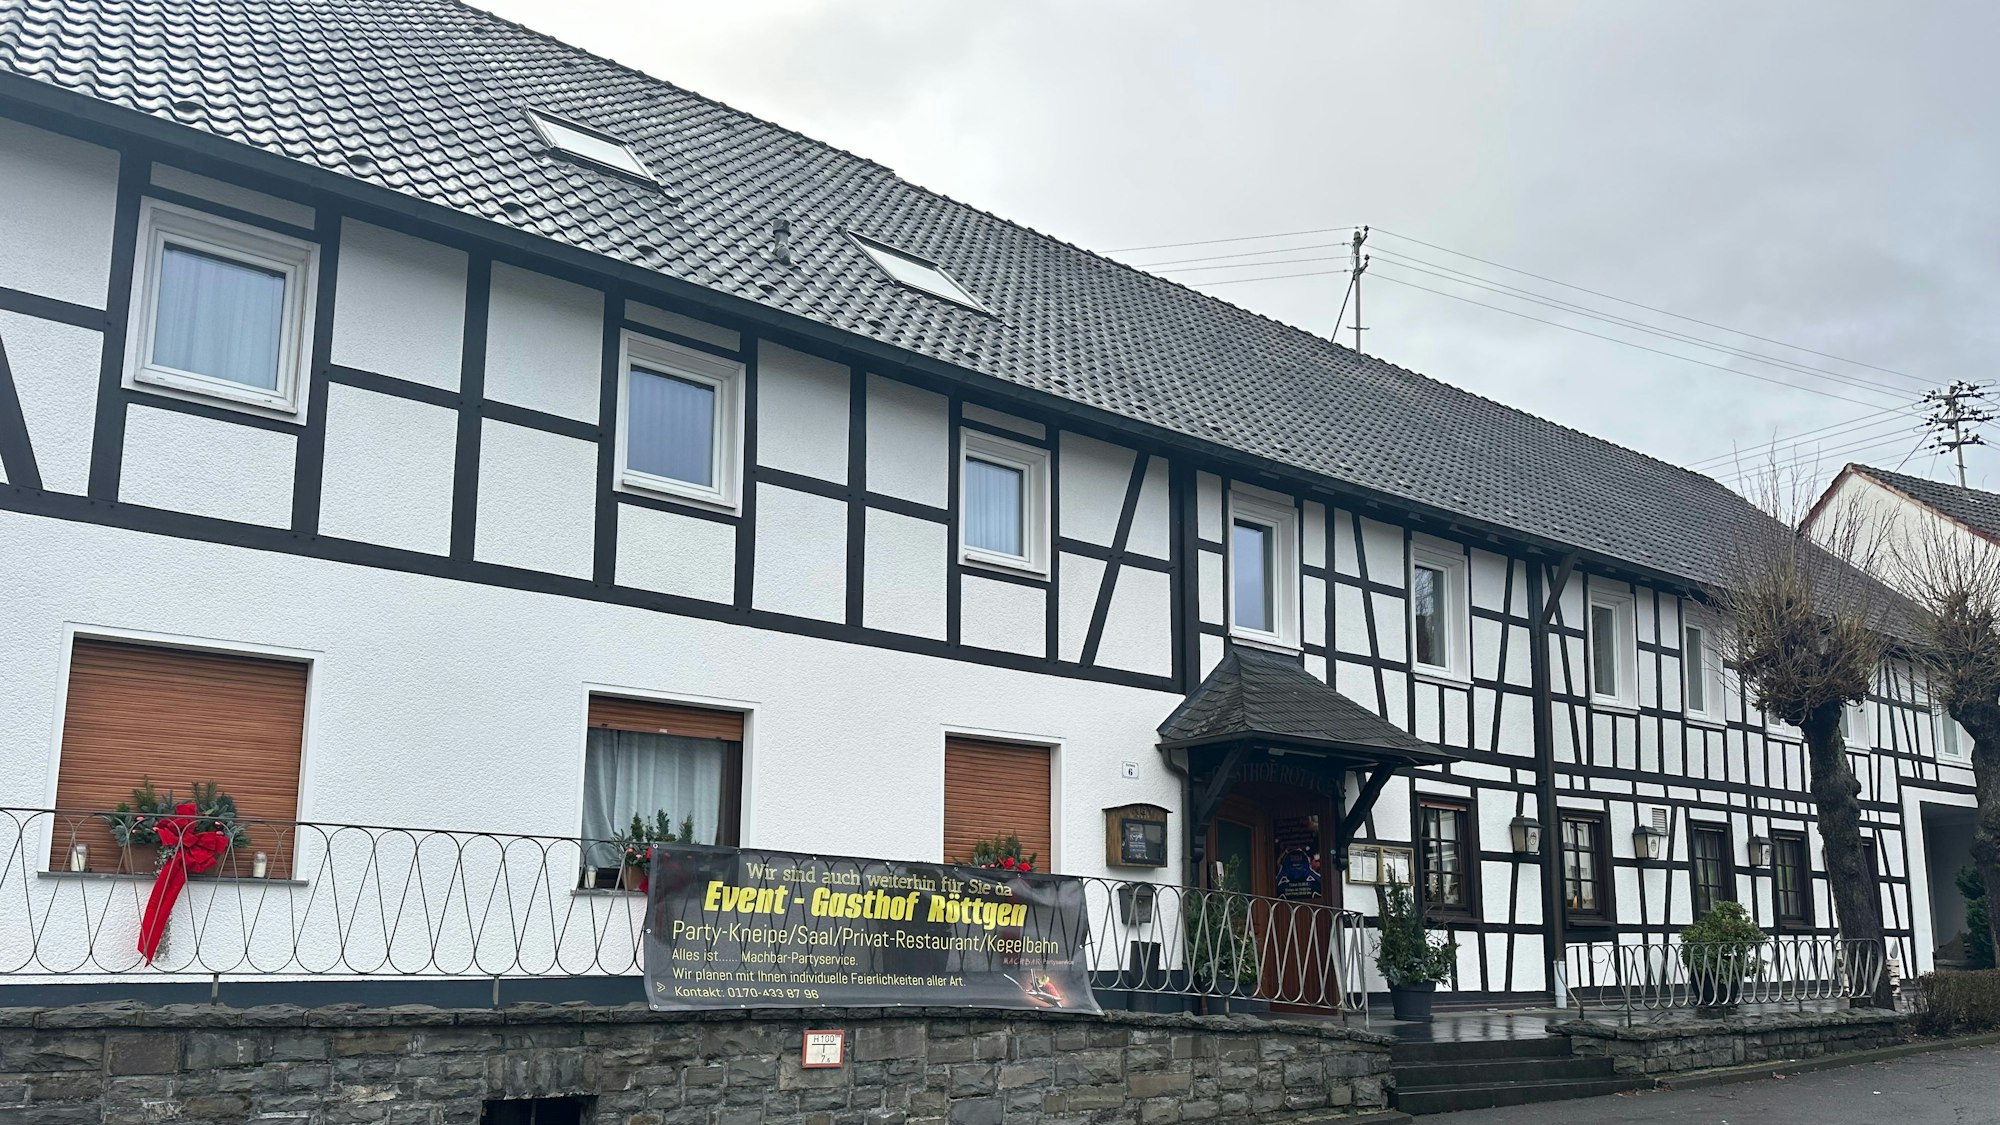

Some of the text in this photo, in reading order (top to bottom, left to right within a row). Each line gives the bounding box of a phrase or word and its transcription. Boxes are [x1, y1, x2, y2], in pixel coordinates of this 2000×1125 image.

[1128, 768, 1133, 776] 6
[1212, 762, 1280, 783] GSTHOF
[746, 862, 1013, 897] Wir sind auch weiterhin für Sie da
[703, 880, 1028, 930] Event - Gasthof Röttgen
[672, 919, 1059, 955] Party-Kneipe/Saal/Privat-Restaurant/Kegelbahn
[671, 948, 700, 961] Alles
[741, 950, 858, 967] Machbar-Partyservice.
[672, 967, 966, 987] Wir planen mit Ihnen individuelle Feierlichkeiten aller Art.
[674, 986, 819, 999] Kontakt: 0170-433 87 96
